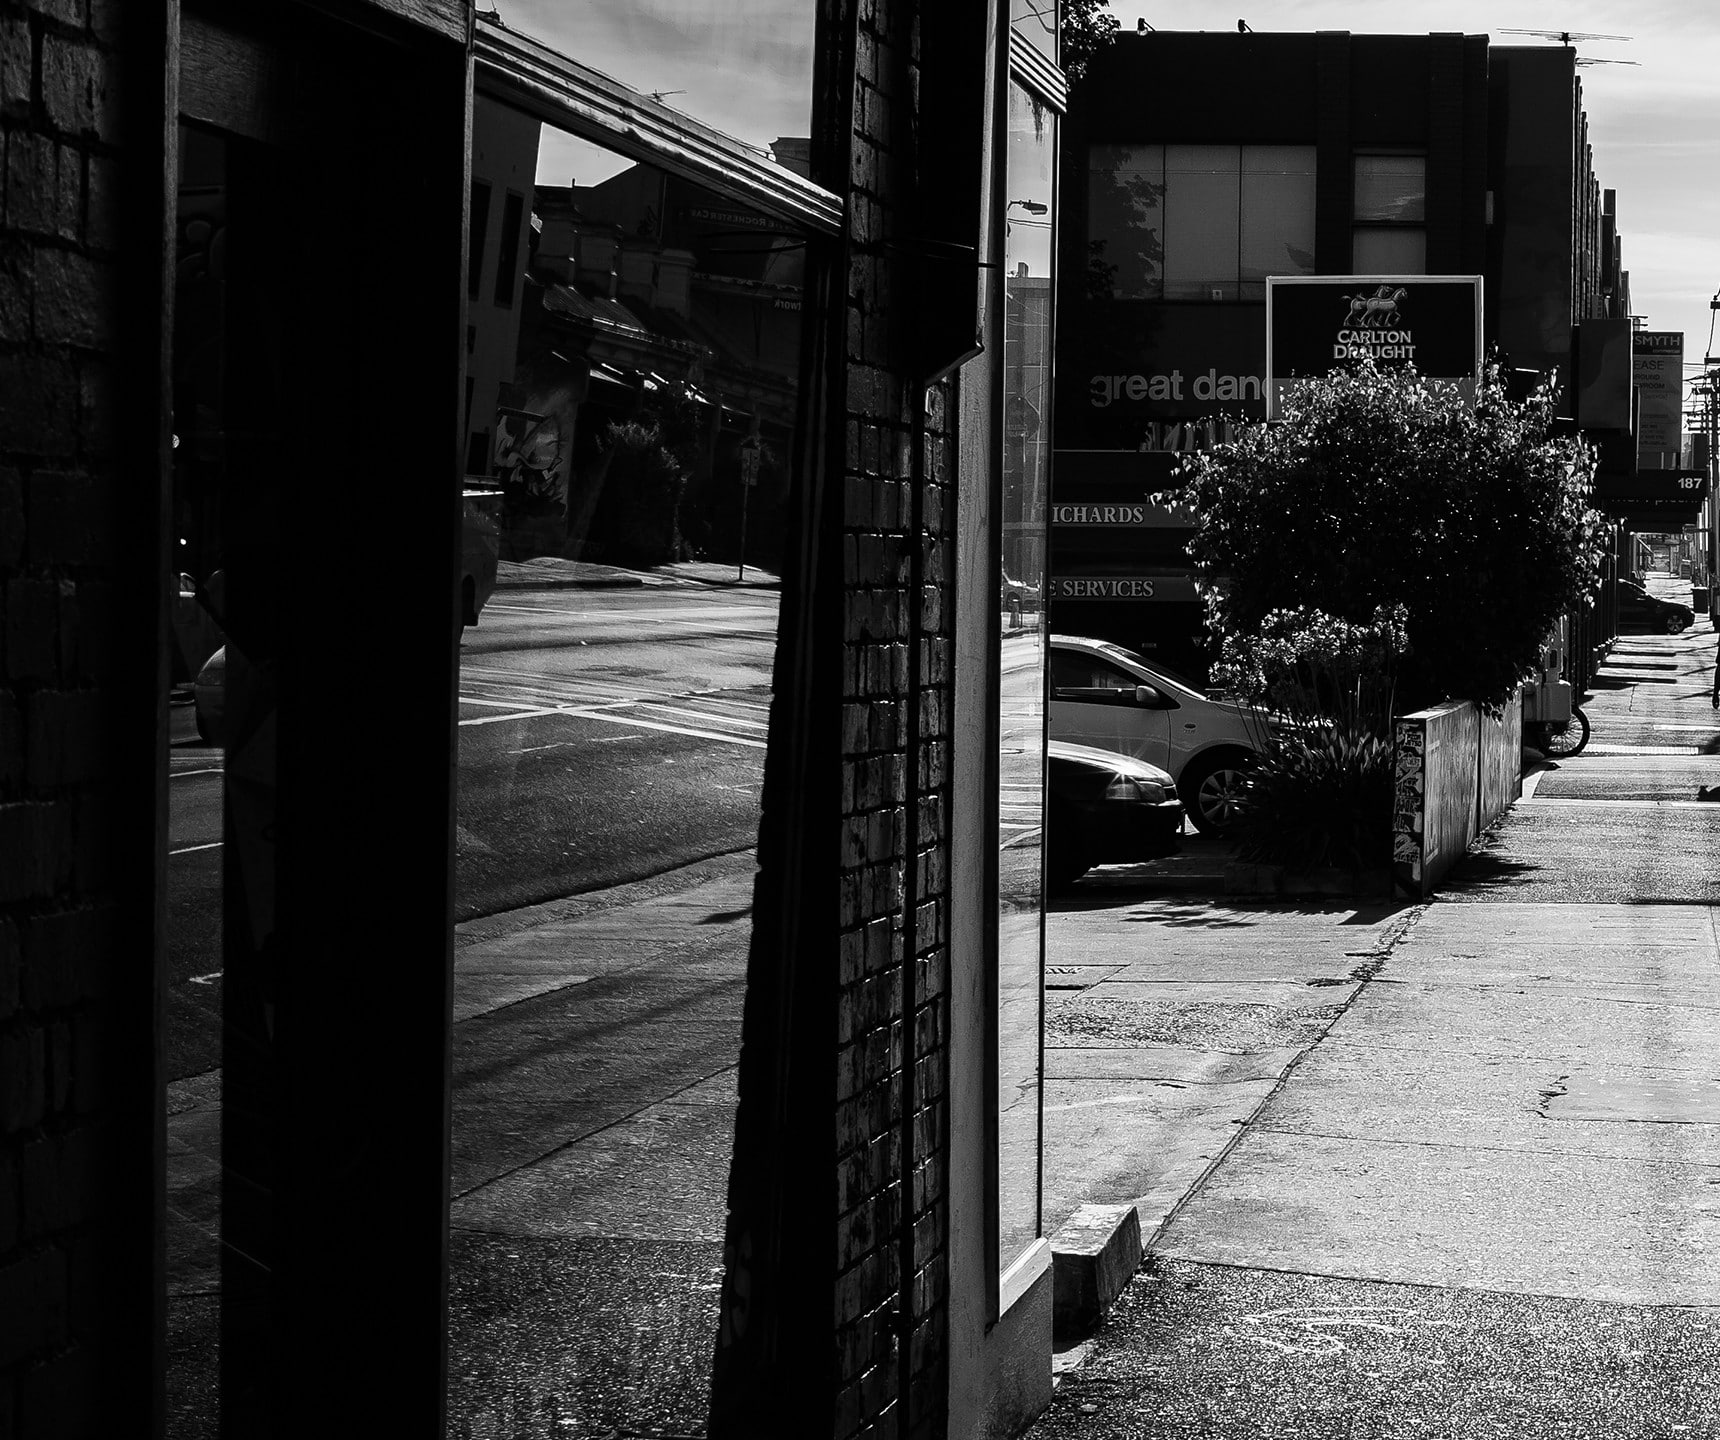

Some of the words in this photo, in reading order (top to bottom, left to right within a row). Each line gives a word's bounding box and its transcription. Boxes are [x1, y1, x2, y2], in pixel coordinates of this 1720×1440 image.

[1337, 329, 1412, 344] CARLTON
[1634, 335, 1680, 347] SMYTH
[1090, 368, 1185, 408] great
[1677, 477, 1703, 489] 187
[1052, 506, 1144, 523] ICHARDS
[1062, 580, 1154, 597] SERVICES
